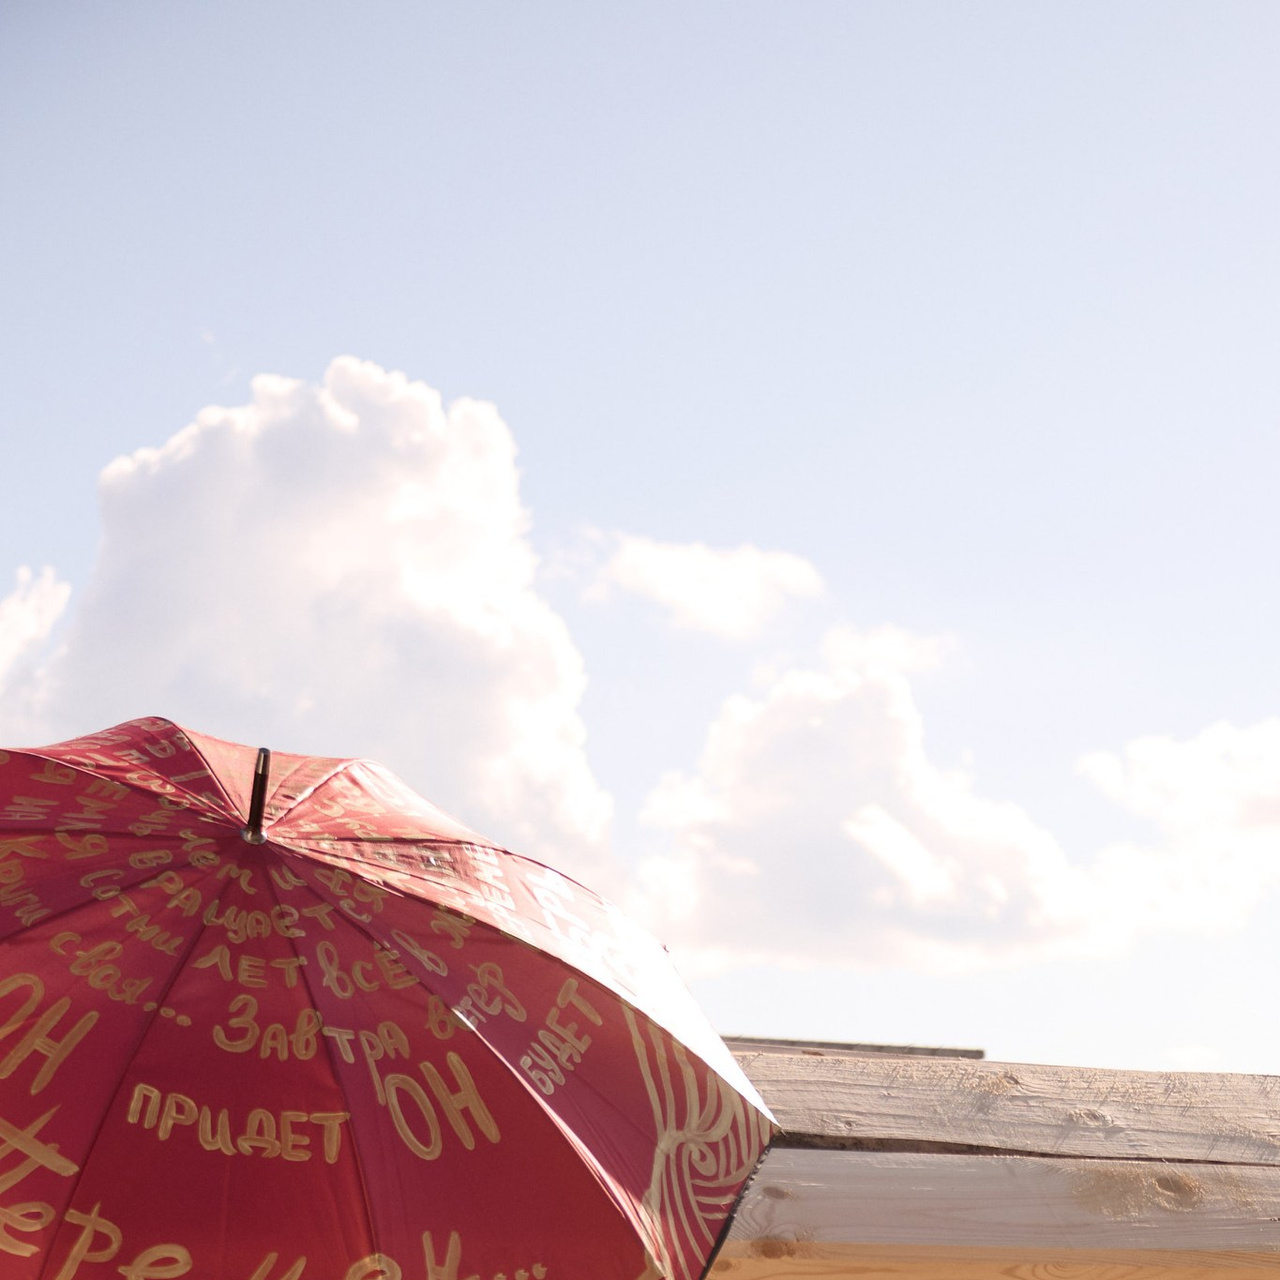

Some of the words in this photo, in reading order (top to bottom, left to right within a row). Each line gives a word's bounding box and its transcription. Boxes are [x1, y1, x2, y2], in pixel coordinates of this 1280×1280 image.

[127, 1082, 350, 1164] ПРИДЕТ
[382, 1051, 501, 1161] ОН
[519, 979, 604, 1096] БУДЕТ
